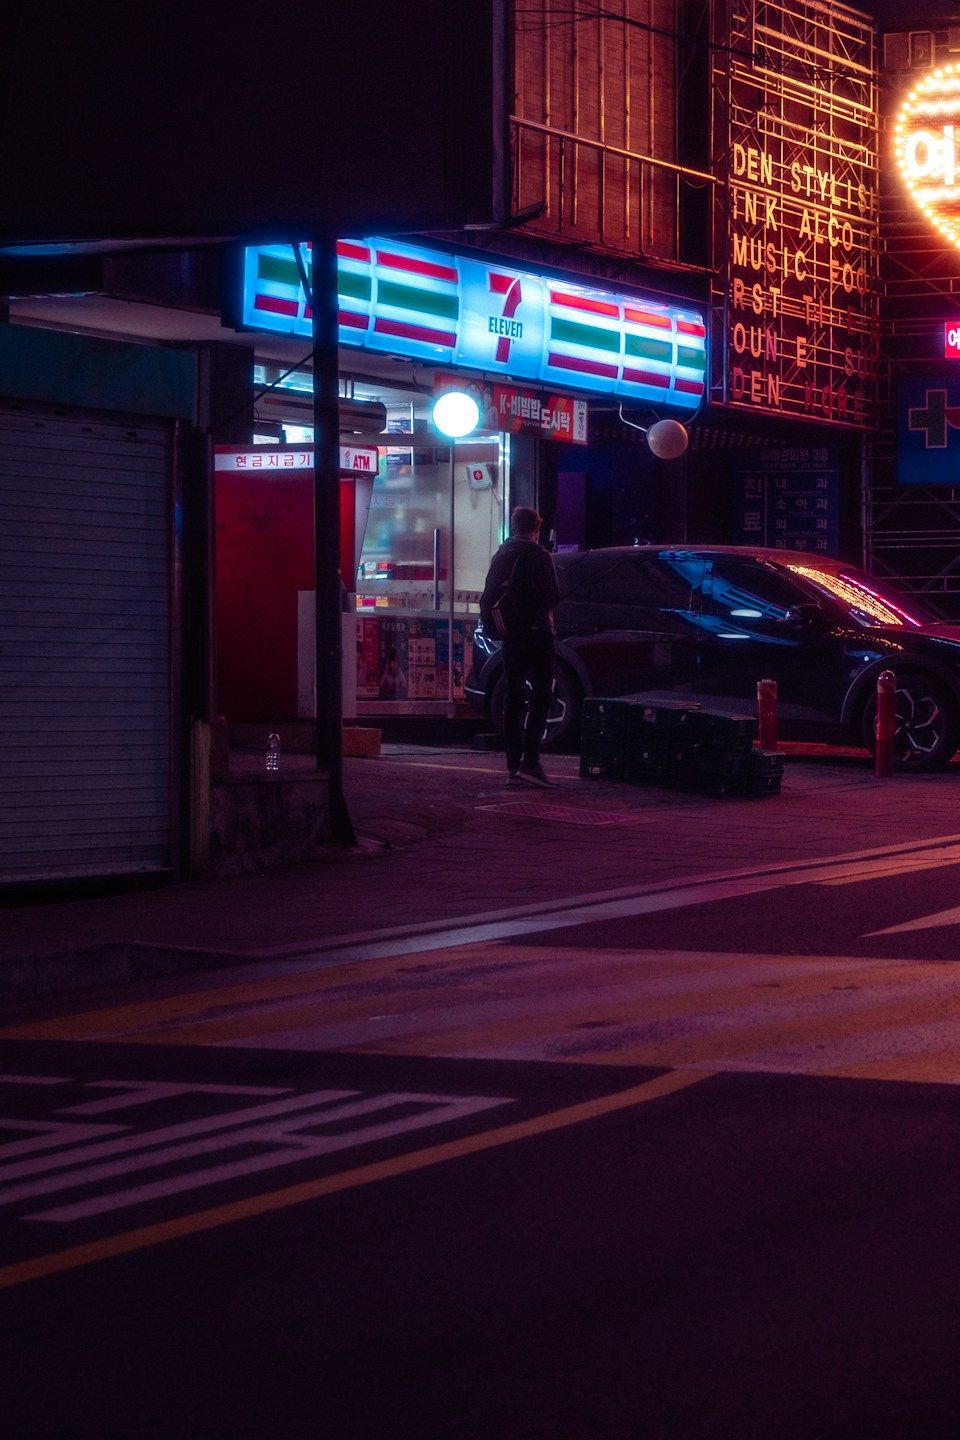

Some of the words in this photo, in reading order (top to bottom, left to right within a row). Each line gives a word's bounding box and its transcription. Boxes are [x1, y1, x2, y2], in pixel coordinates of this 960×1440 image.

[733, 143, 773, 186] DEN
[733, 233, 806, 282] MUSIC
[541, 408, 570, 433] 도시락
[235, 454, 310, 468] 현금지급기
[352, 453, 370, 471] ATM
